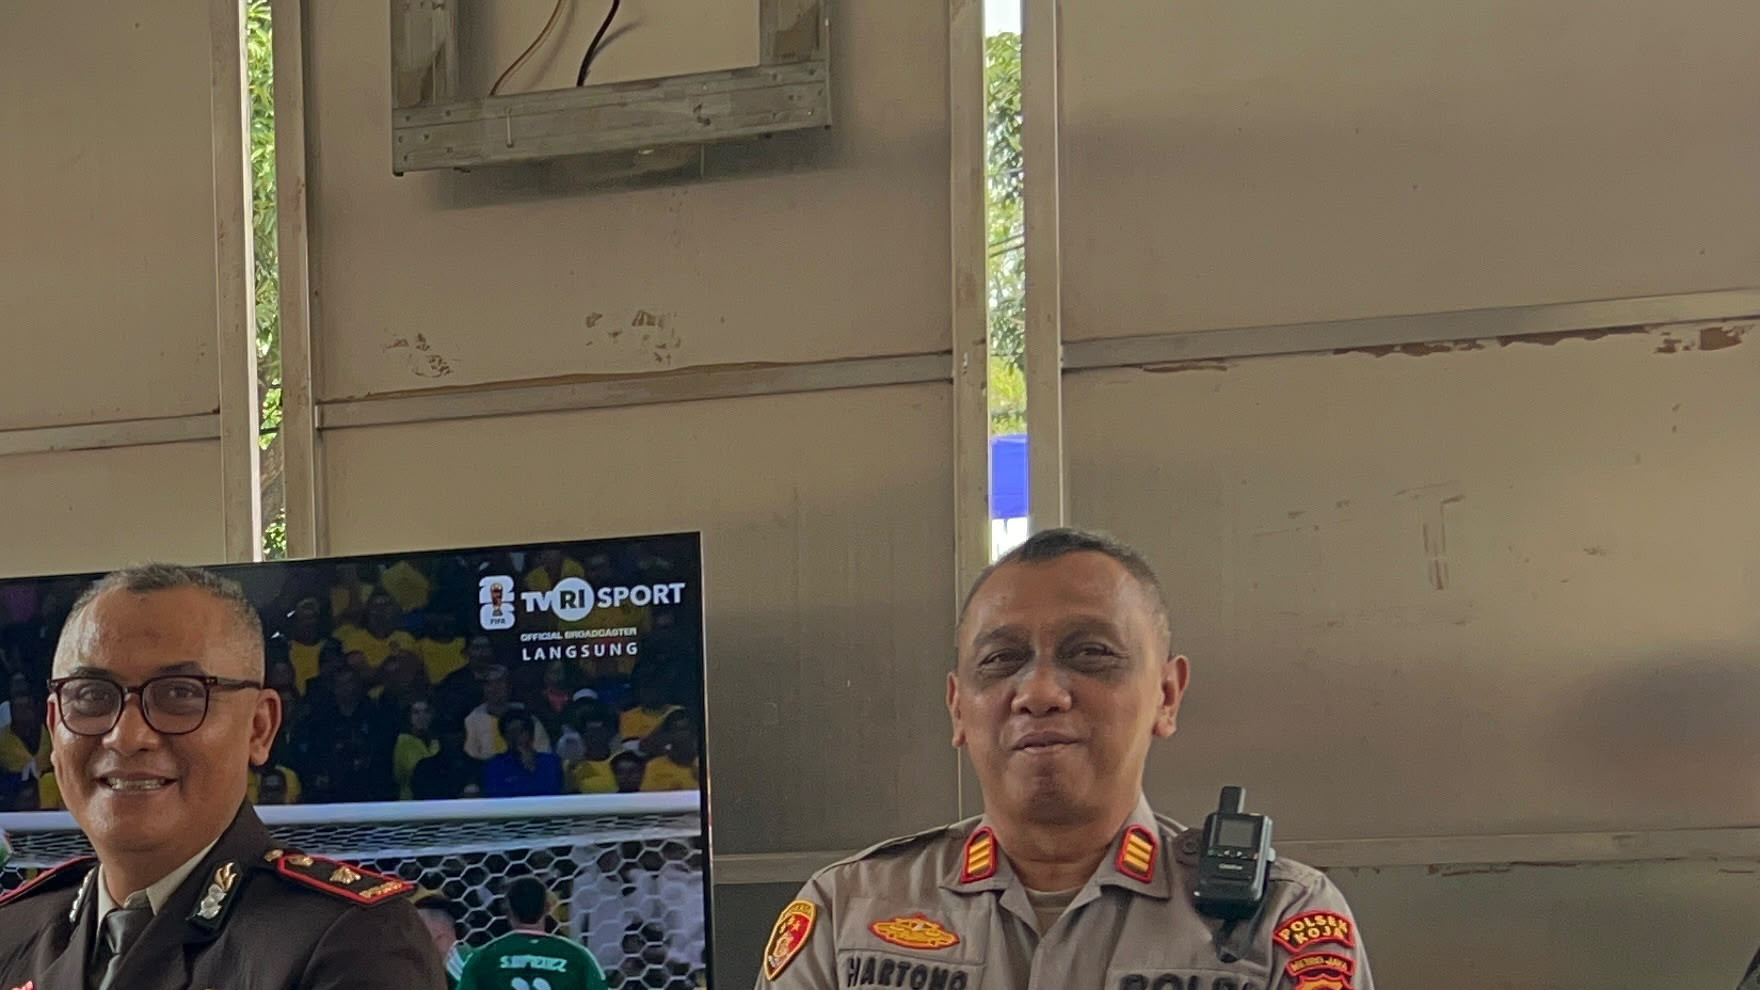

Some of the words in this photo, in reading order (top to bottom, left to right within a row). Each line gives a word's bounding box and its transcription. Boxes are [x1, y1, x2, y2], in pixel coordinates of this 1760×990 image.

[597, 582, 686, 608] SPORT
[521, 632, 563, 642] OFFICIAL
[564, 627, 637, 639] BROADCASTER
[522, 642, 638, 661] LANGSUNG
